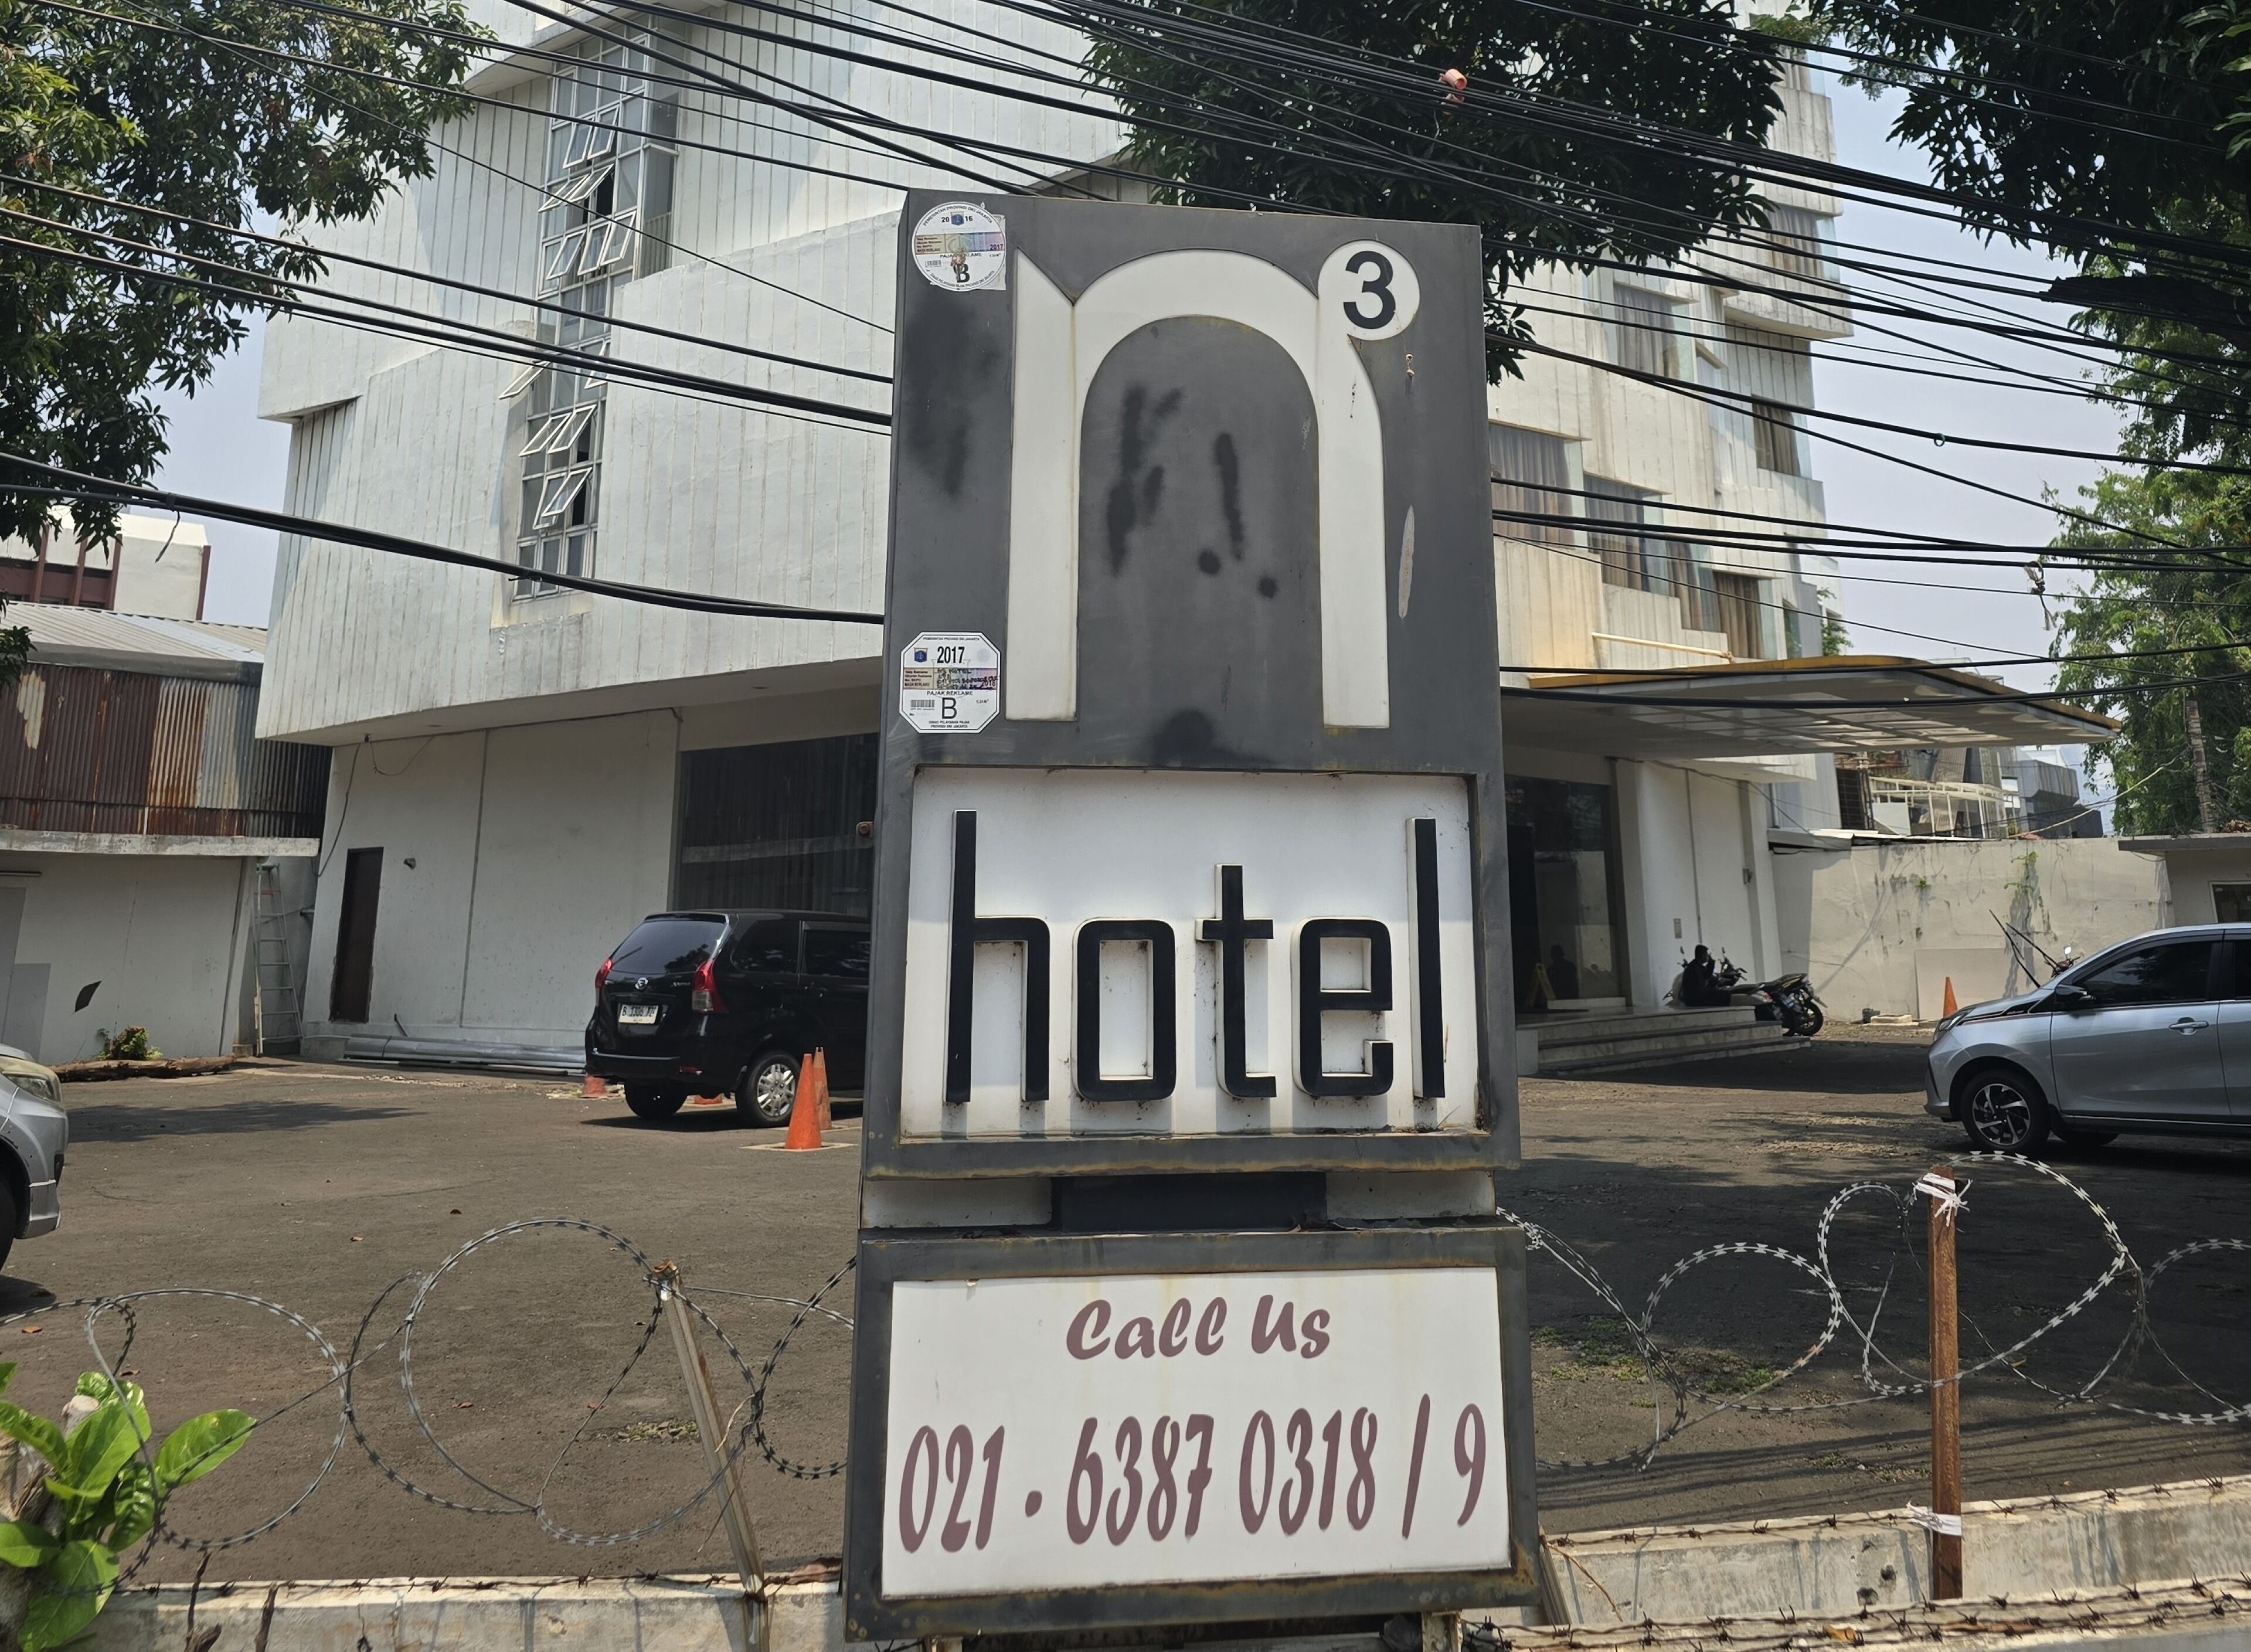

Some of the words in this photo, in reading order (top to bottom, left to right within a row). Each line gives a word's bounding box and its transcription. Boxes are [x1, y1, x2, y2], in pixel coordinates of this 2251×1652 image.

[953, 264, 970, 283] B
[937, 646, 965, 664] 2017
[942, 698, 957, 719] B
[944, 810, 1444, 1103] hotel
[1066, 1296, 1227, 1360] Call
[1250, 1294, 1331, 1359] Us
[898, 1423, 1005, 1552] 021
[1065, 1413, 1215, 1546] 6387
[1239, 1407, 1378, 1537] 0318
